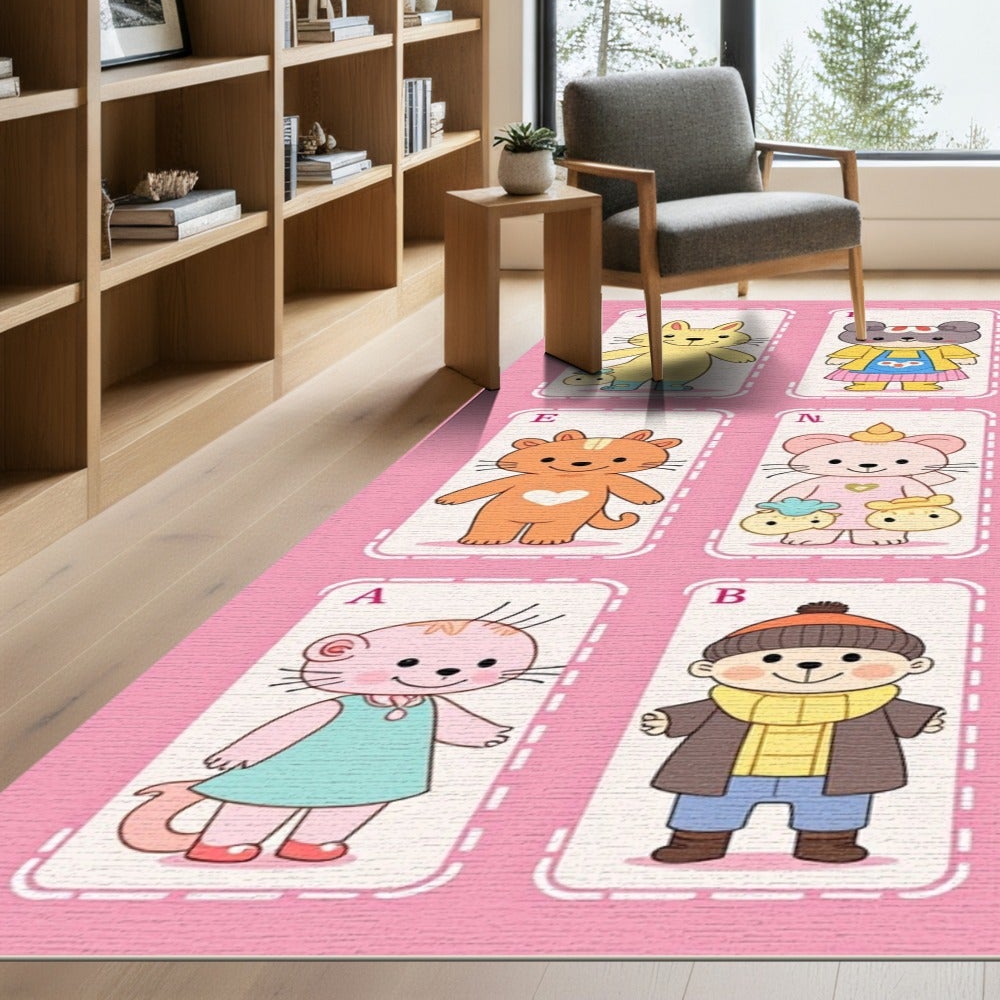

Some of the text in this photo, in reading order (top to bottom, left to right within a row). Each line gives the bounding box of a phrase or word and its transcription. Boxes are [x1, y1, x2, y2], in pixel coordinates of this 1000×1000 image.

[529, 413, 559, 423] E
[342, 587, 385, 604] A
[710, 587, 747, 604] B
